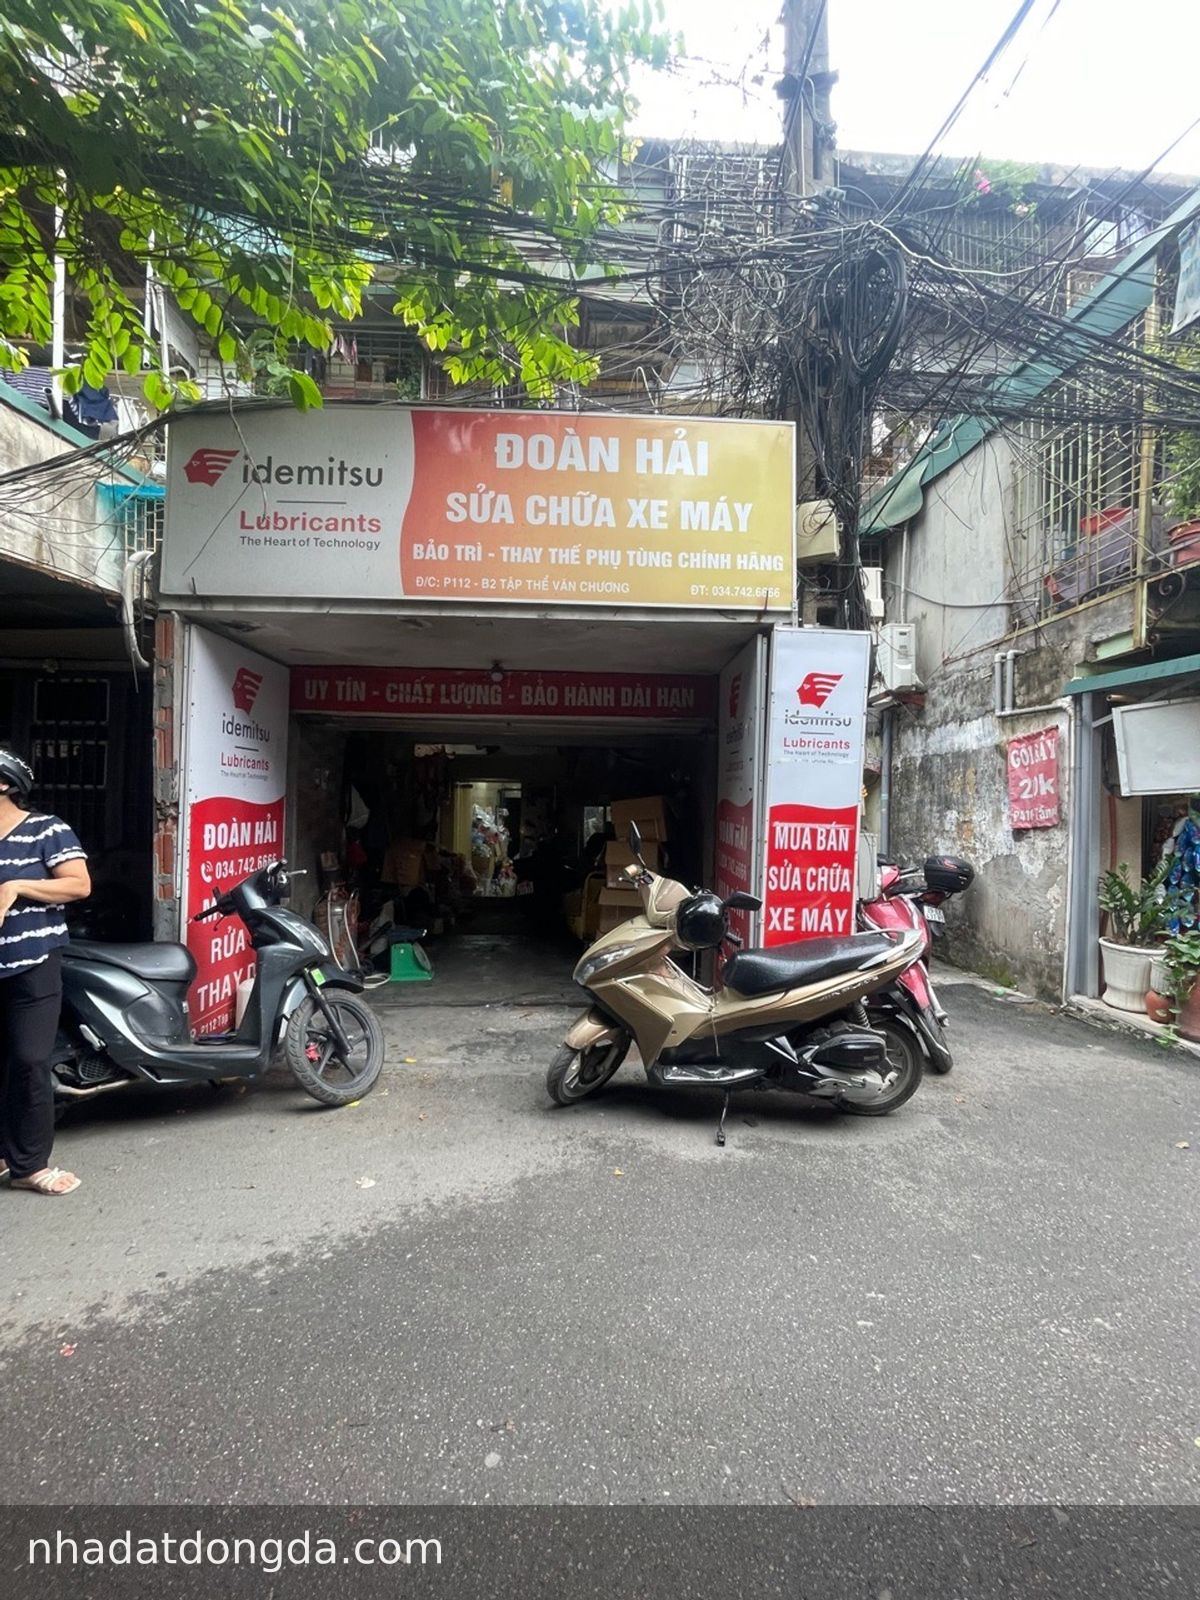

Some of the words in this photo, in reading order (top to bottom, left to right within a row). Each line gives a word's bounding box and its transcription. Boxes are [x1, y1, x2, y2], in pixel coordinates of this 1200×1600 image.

[494, 427, 620, 473] ĐOÀN
[636, 427, 709, 476] HẢI
[242, 454, 384, 487] idemitsu
[239, 511, 382, 533] Lubricants
[446, 484, 515, 525] SỬA
[526, 492, 617, 528] CHỮA
[627, 499, 668, 530] XE
[681, 495, 753, 533] MÁY
[239, 536, 262, 547] The
[264, 537, 296, 547] Heart
[297, 537, 310, 548] of
[313, 538, 381, 551] Technology
[413, 539, 449, 561] BẢO
[455, 541, 482, 561] TRÌ
[500, 546, 543, 564] THAY
[548, 543, 581, 565] THẾ
[586, 549, 621, 570] PHỤ
[627, 547, 672, 568] TÙNG
[678, 549, 731, 570] CHÍNH
[416, 576, 440, 588] Đ/C:
[443, 577, 471, 588] P112
[481, 578, 496, 589] B2
[500, 576, 522, 591] TẬP
[525, 575, 549, 591] THỂ
[579, 580, 630, 593] CHƯƠNG
[690, 584, 708, 596] ĐT:
[712, 585, 780, 598] 034.742.6666
[304, 680, 329, 699] UY
[336, 675, 366, 701] TÍN
[385, 678, 433, 704] CHẤT
[440, 682, 502, 709] LƯỢNG
[521, 678, 559, 707] BẢO
[564, 681, 615, 707] HÀNH
[620, 683, 651, 708] DÀI
[657, 687, 696, 713] HẠN
[222, 713, 270, 742] idemitsu
[783, 737, 851, 750] Lubricants
[221, 752, 270, 771] Lubricants
[203, 818, 250, 851] ĐOÀN
[255, 813, 277, 845] HẢI
[774, 824, 813, 851] MUA
[816, 821, 849, 851] BÁN
[768, 859, 801, 892] SỬA
[806, 863, 851, 893] CHỮA
[768, 907, 795, 932] XE
[801, 901, 848, 933] MÁY
[210, 926, 246, 964] RỬA
[197, 968, 243, 1012] THAY
